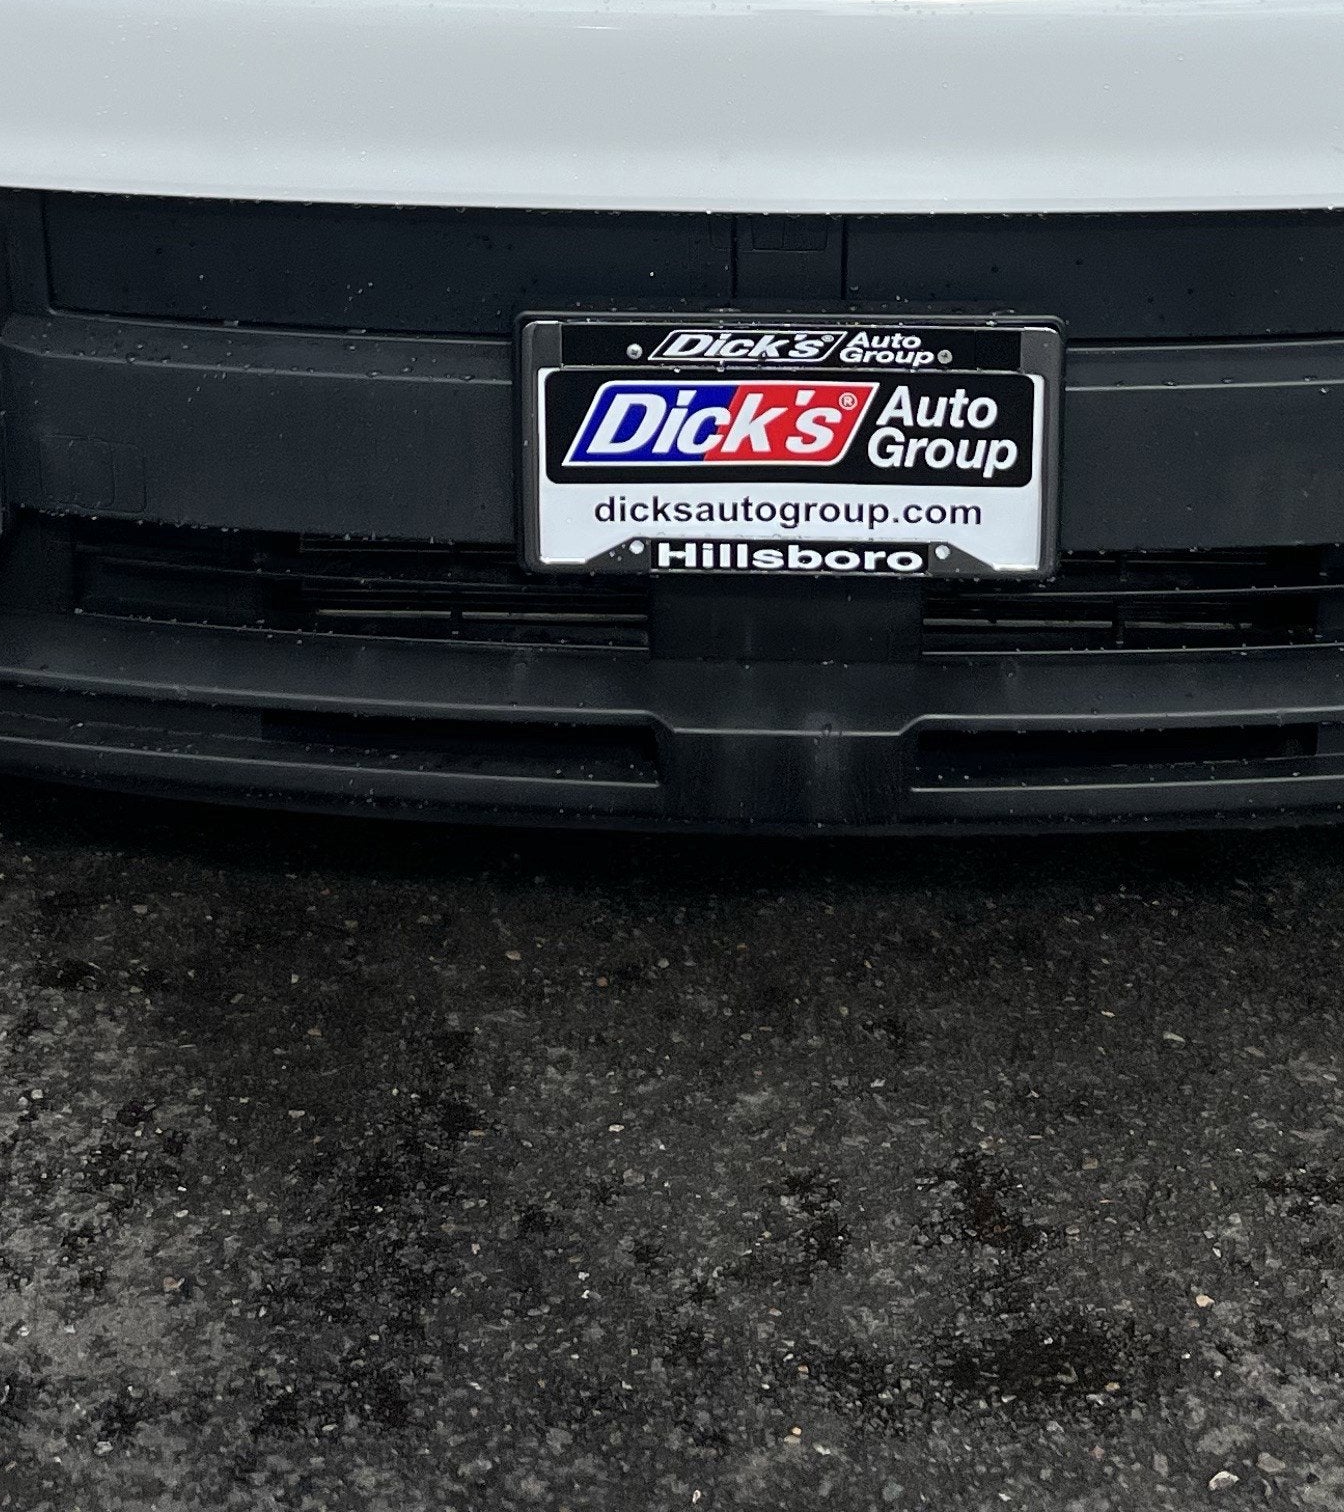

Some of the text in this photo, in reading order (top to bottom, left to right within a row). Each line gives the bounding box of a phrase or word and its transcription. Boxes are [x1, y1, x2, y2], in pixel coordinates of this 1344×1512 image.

[662, 332, 922, 359] Dick's Auto
[839, 347, 935, 366] Group
[584, 385, 998, 455] Dick's Auto
[866, 428, 1019, 478] Group
[594, 495, 982, 530] dicksautogroup.com
[657, 543, 924, 573] Hillsboro
